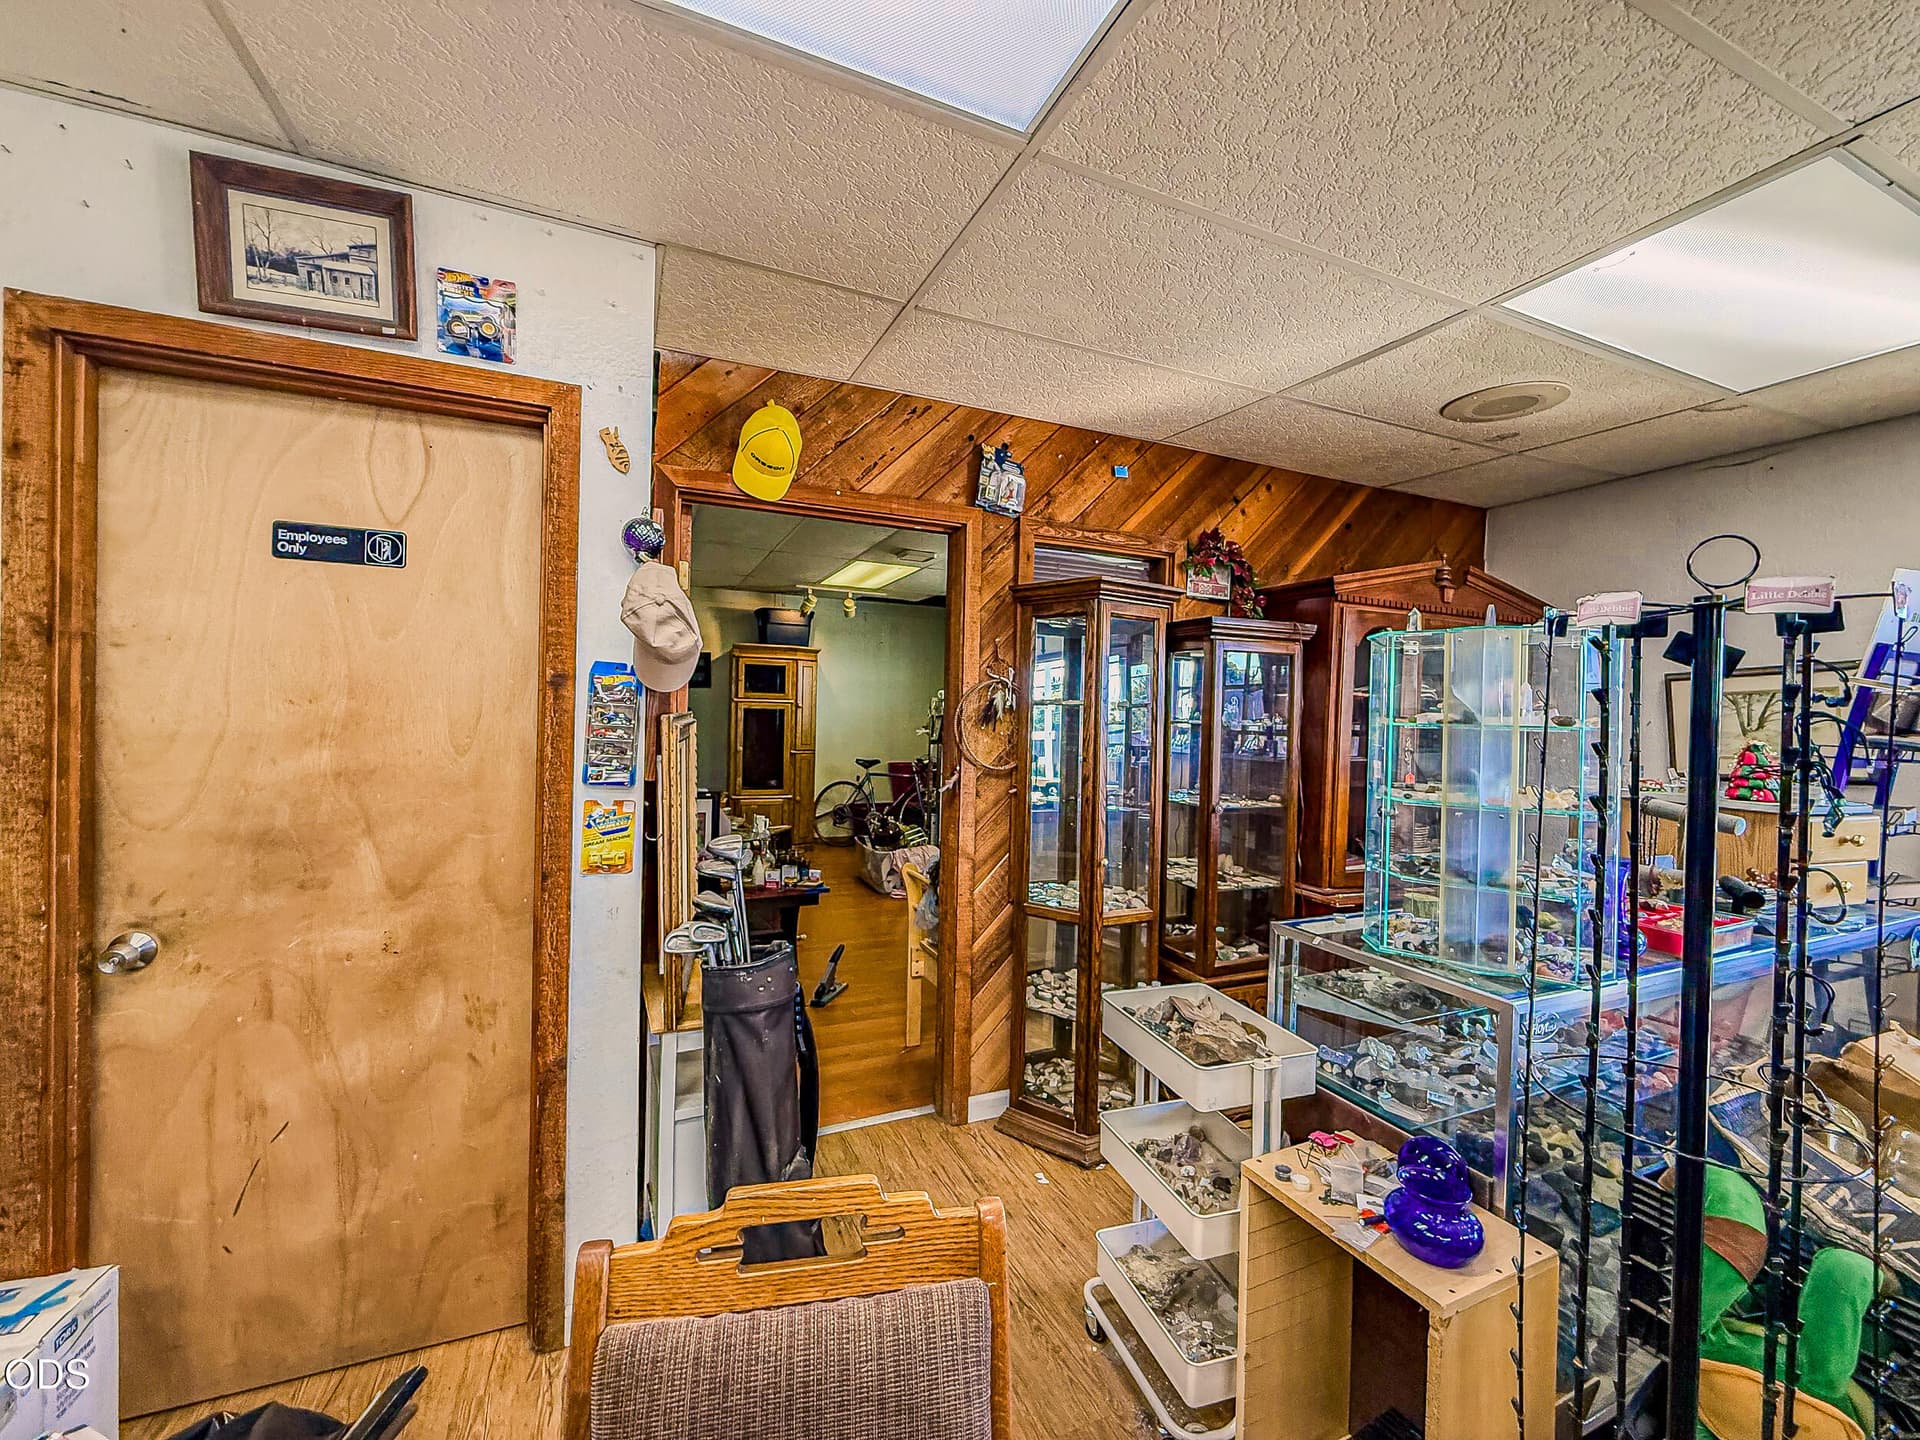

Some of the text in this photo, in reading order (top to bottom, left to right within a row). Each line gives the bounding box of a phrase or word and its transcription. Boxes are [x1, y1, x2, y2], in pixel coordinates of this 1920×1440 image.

[277, 528, 348, 546] Employees
[276, 541, 307, 556] Only
[1751, 590, 1784, 601] Little
[54, 1322, 78, 1350] TORK
